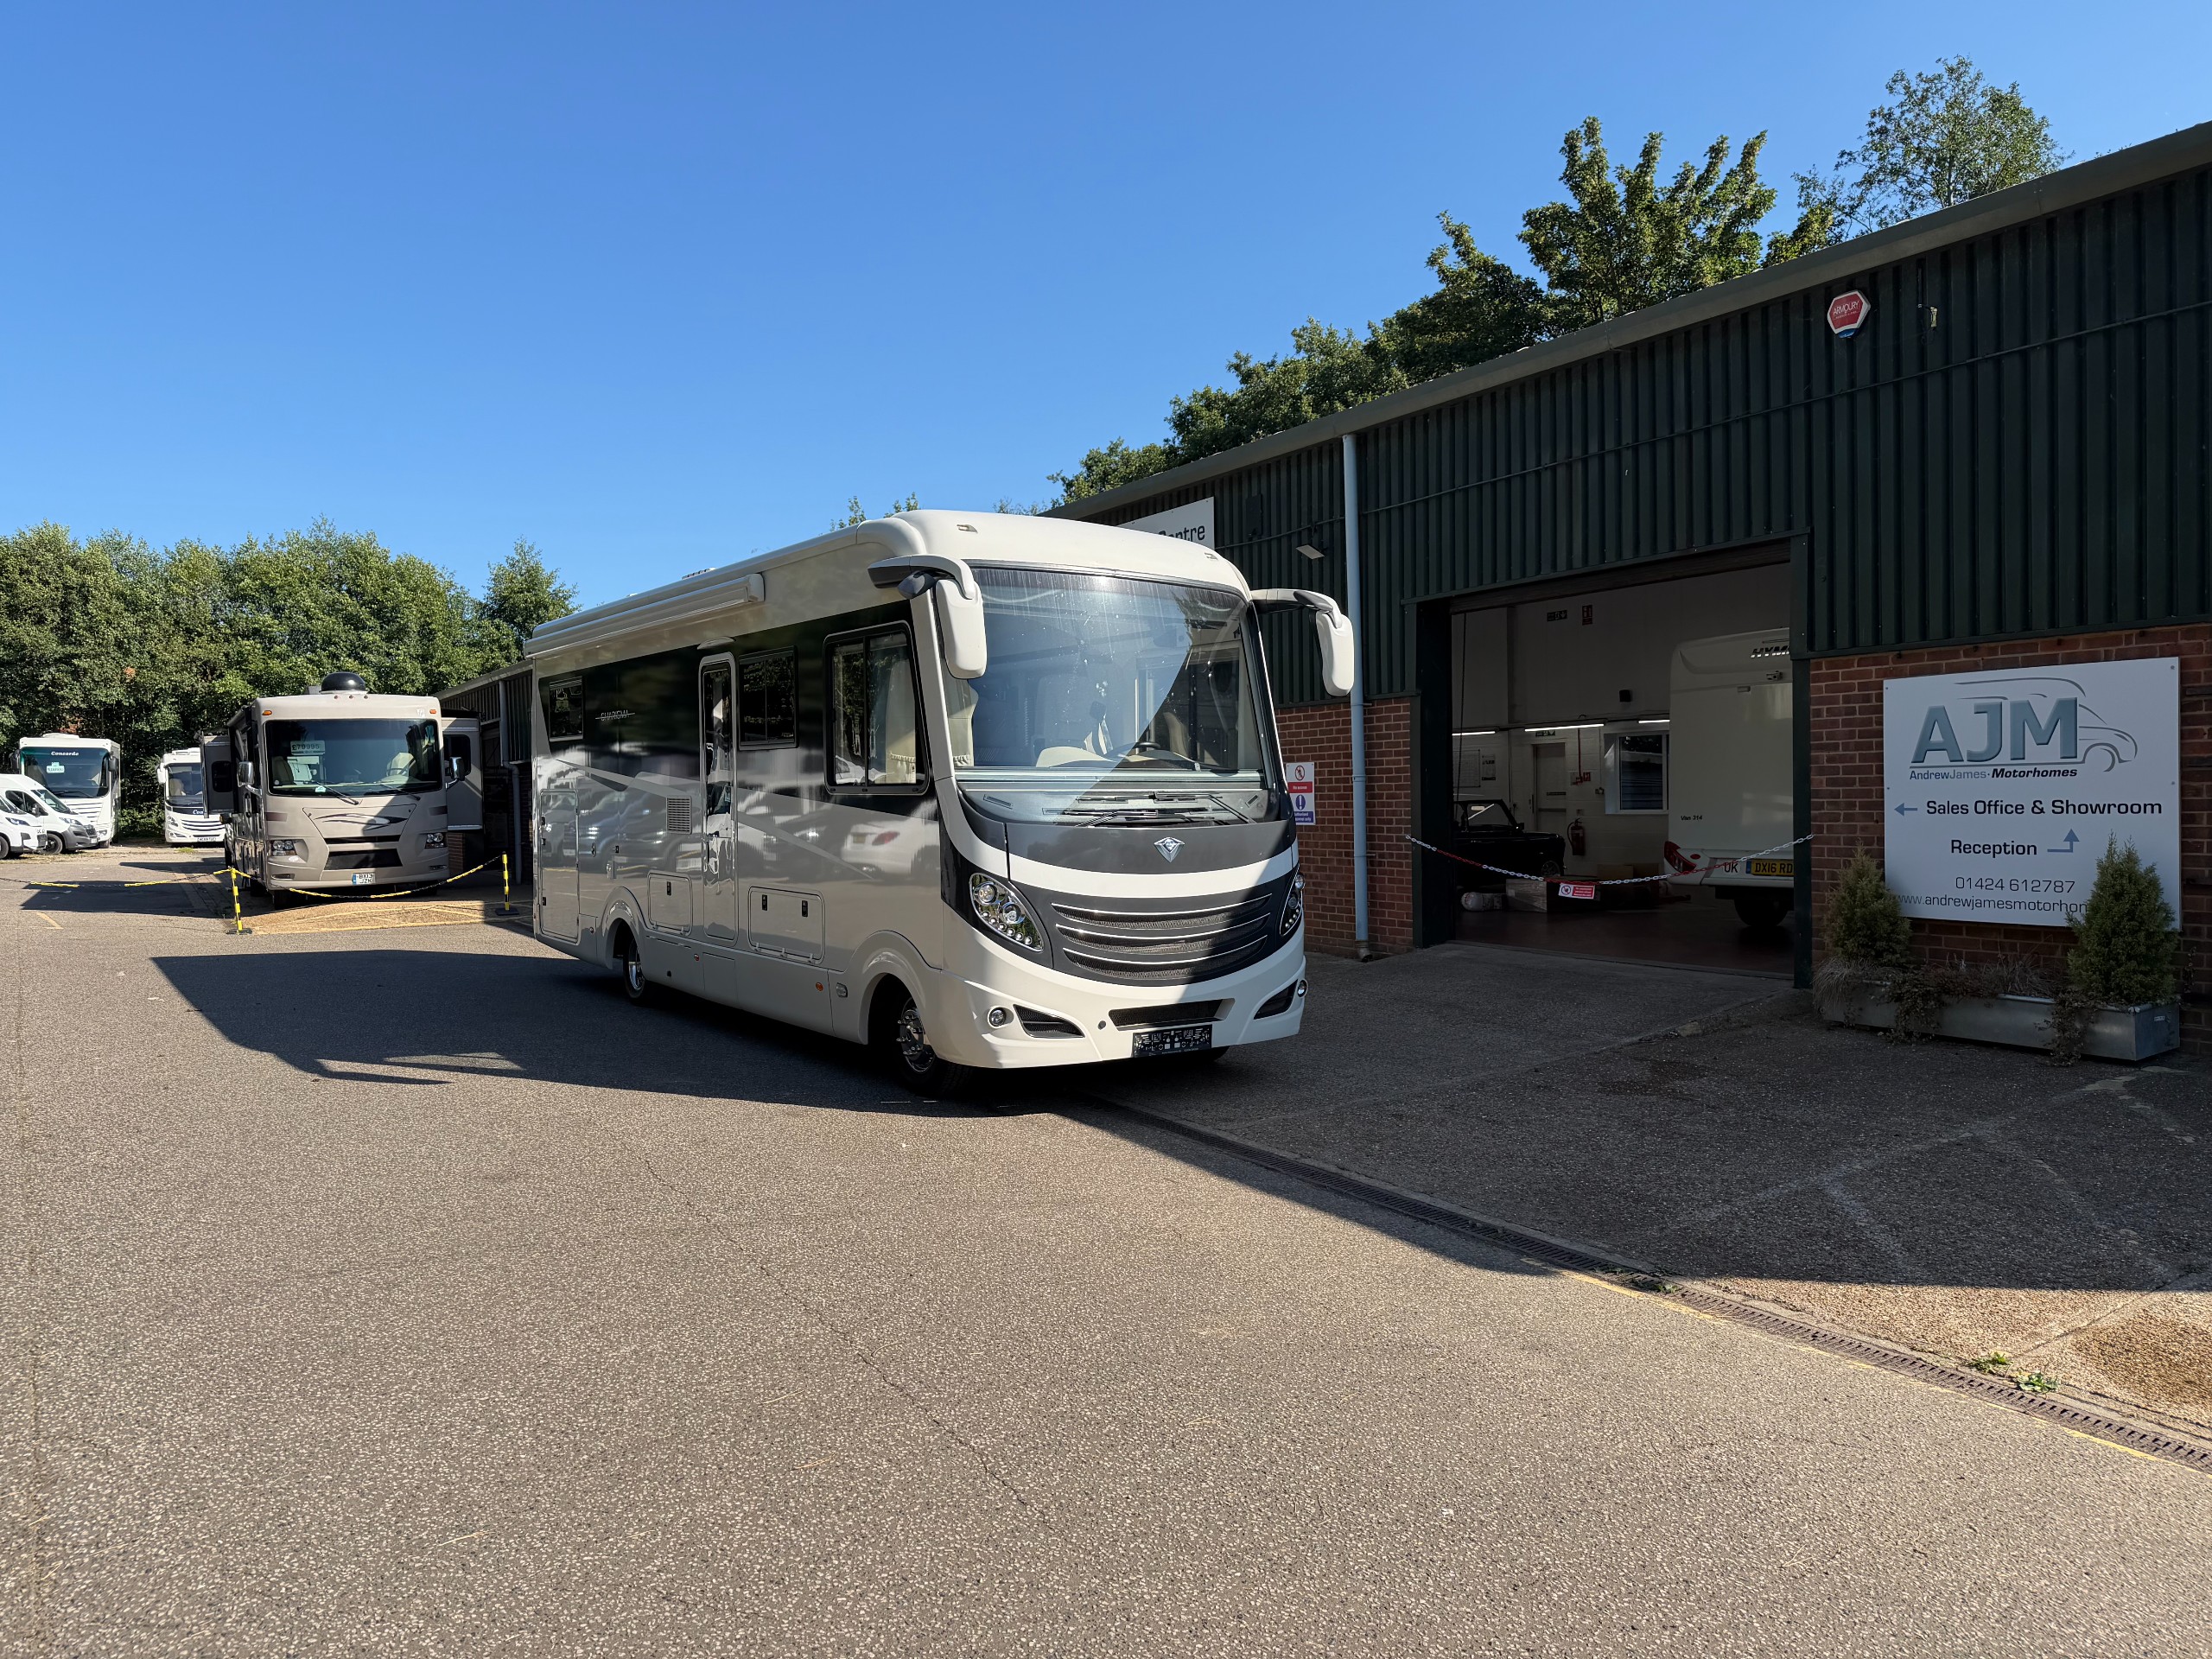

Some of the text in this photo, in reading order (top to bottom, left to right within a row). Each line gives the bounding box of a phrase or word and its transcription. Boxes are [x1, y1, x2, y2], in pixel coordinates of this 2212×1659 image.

[1159, 525, 1205, 542] ntre
[1911, 697, 2077, 763] AJM
[1991, 767, 2078, 779] Motorhomes
[1926, 799, 2162, 815] Sales Office & Showroom
[1950, 839, 2037, 859] Reception
[1724, 862, 1738, 873] UK
[1755, 862, 1777, 873] DX16
[1955, 876, 2075, 893] 01424 612787
